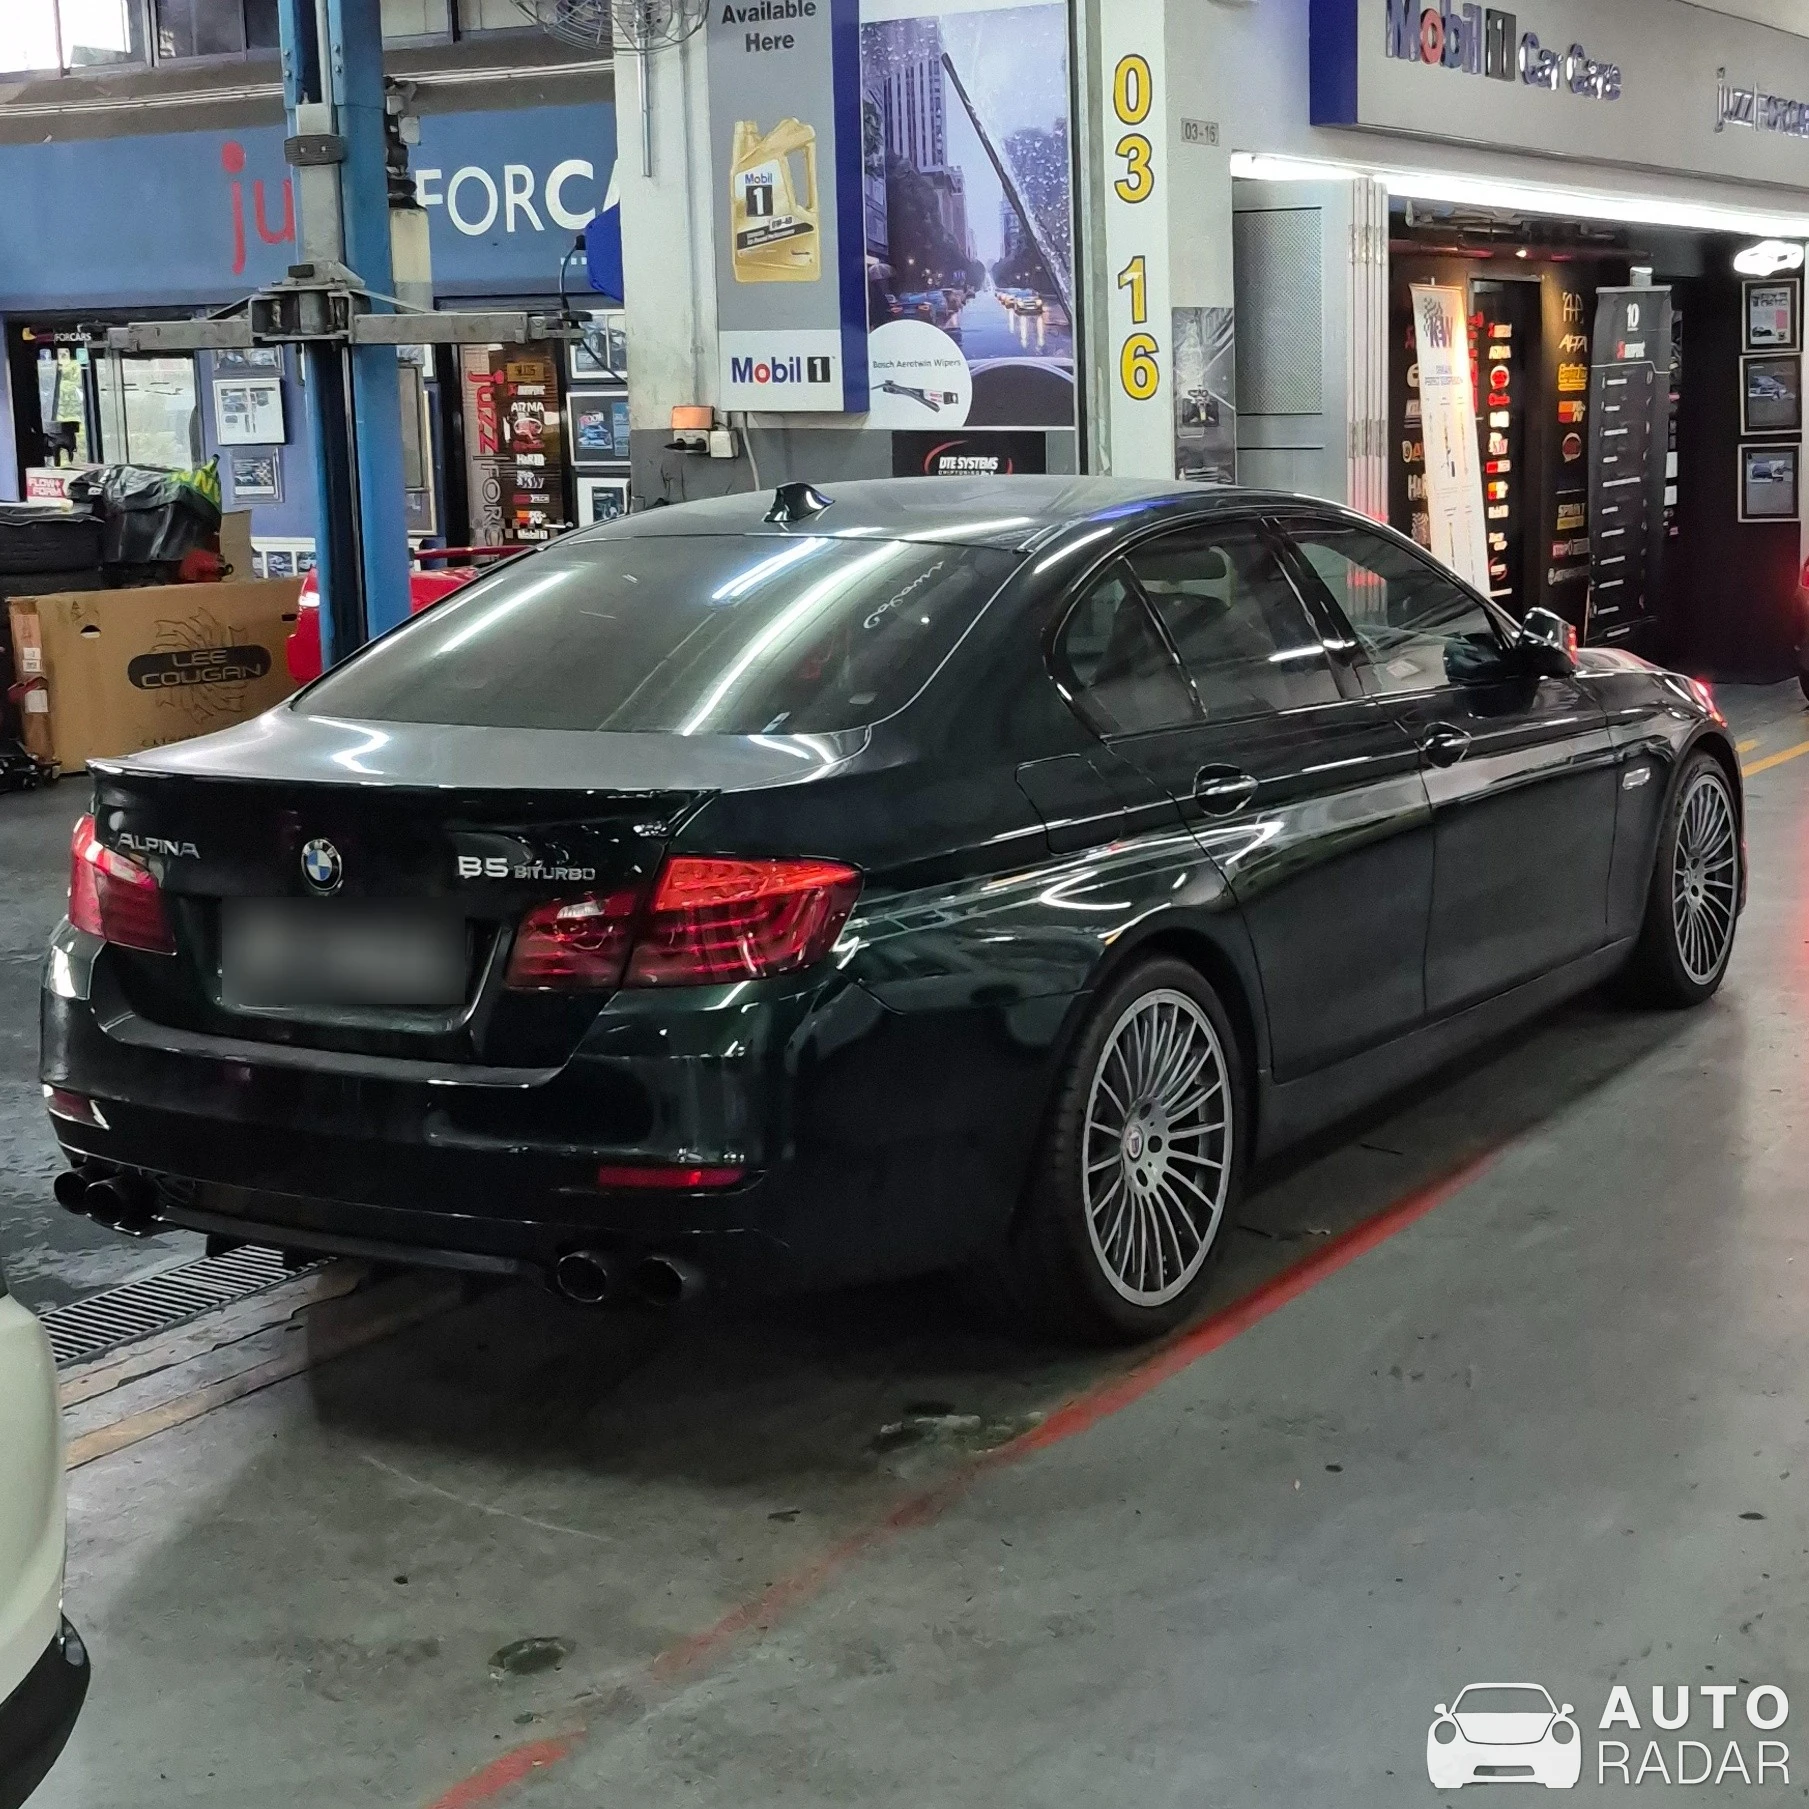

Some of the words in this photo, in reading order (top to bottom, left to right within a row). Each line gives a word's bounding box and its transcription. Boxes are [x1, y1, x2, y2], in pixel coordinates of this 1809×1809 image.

[722, 0, 817, 24] Available
[745, 32, 795, 52] Here
[1386, 0, 1482, 75] Mobil
[1519, 31, 1563, 90] Car
[745, 173, 773, 184] Mobil
[221, 140, 295, 276] ju
[1626, 303, 1640, 328] 10
[54, 332, 91, 342] FORCARS
[731, 356, 801, 383] Mobil
[872, 360, 894, 369] Bosch
[934, 359, 961, 368] Wipers
[467, 369, 505, 455] juzz
[938, 456, 958, 470] DTE
[957, 456, 999, 470] SYSTEMS
[172, 649, 228, 668] LEE
[141, 663, 262, 688] COUGAN
[115, 832, 201, 860] ALPINA
[457, 855, 509, 879] B5
[513, 864, 596, 881] BITURBO
